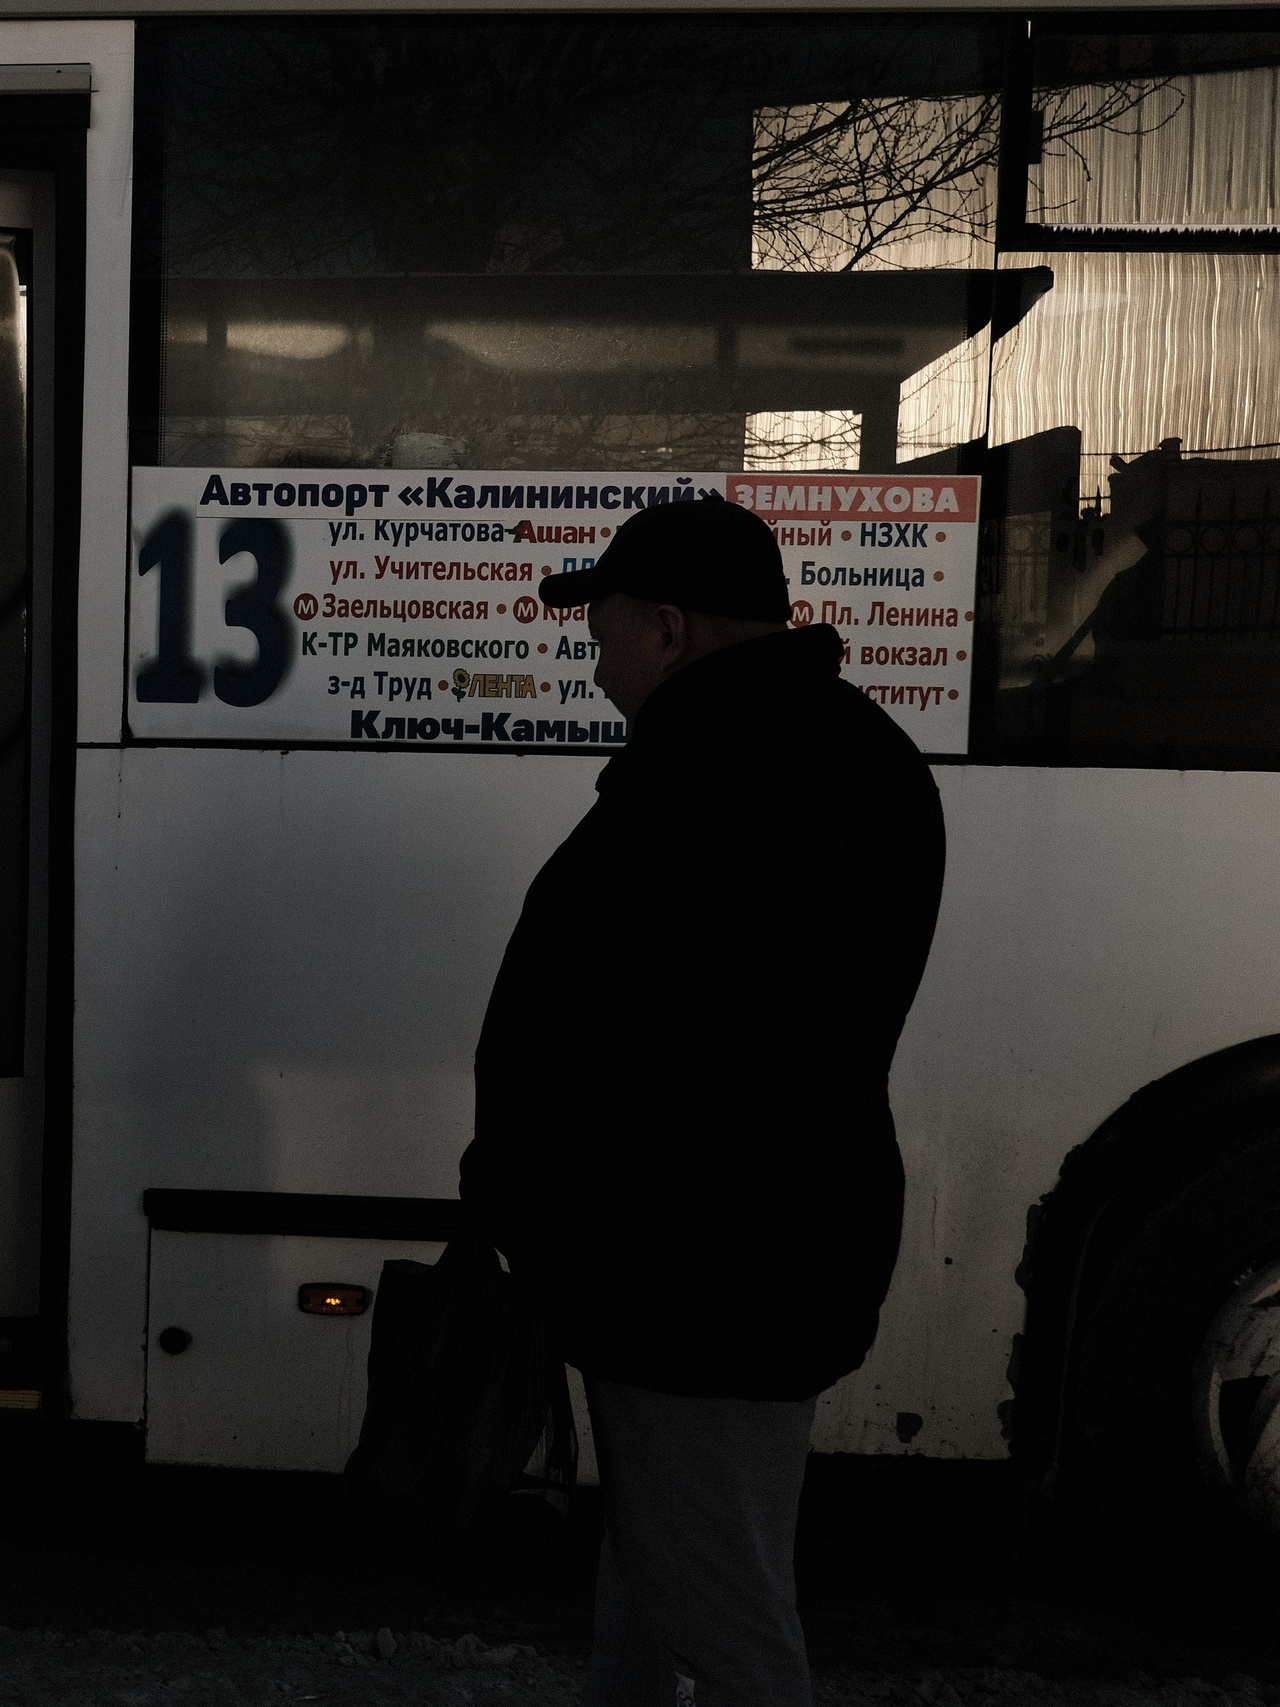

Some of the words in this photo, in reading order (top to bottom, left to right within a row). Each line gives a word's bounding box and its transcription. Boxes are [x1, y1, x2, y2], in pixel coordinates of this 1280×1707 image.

[200, 475, 390, 516] Автопорт
[398, 477, 724, 510] «Калининский»
[734, 484, 960, 513] ЗЕМНУХОВА
[329, 521, 365, 546] ул.
[513, 520, 596, 544] Ашан
[861, 522, 928, 548] НЗХК
[329, 561, 365, 585] ул.
[375, 556, 533, 582] Учительская
[801, 560, 925, 591] Больница
[135, 507, 293, 707] 13
[323, 595, 489, 622] Заельцовская
[543, 604, 586, 627] Кра
[821, 600, 859, 626] Пл.
[867, 601, 959, 628] Ленина
[302, 632, 358, 657] К-ТР
[367, 633, 530, 660] Маяковского
[555, 635, 600, 660] Авт
[861, 646, 948, 666] вокзал
[328, 676, 366, 699] з-д
[374, 671, 432, 701] Труд
[468, 674, 538, 699] ЛЕНТА
[558, 680, 595, 705] ул.
[858, 685, 945, 711] ститут
[351, 710, 631, 743] Ключ-Камыш
